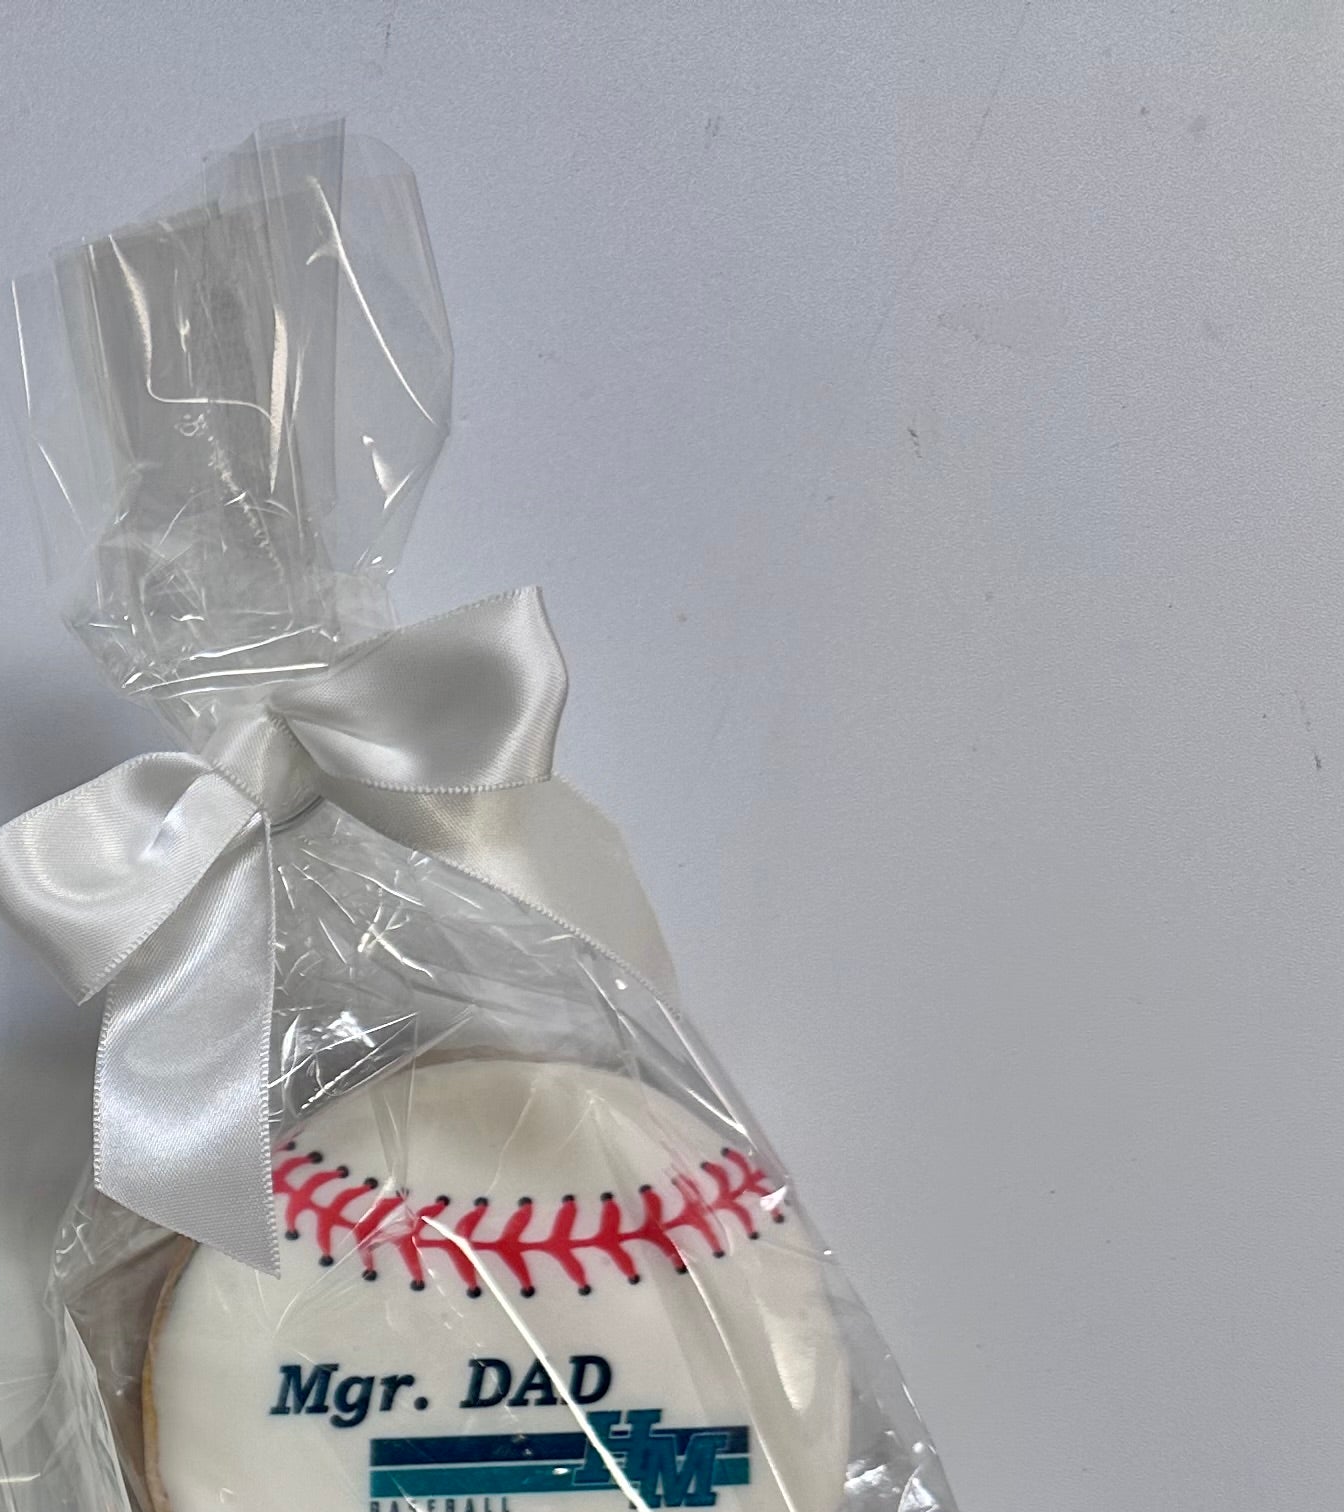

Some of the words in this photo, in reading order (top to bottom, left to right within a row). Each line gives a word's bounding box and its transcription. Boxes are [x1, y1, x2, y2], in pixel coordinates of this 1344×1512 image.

[269, 1363, 429, 1428] Mgr.
[459, 1354, 612, 1408] DAD
[572, 1408, 727, 1509] HM
